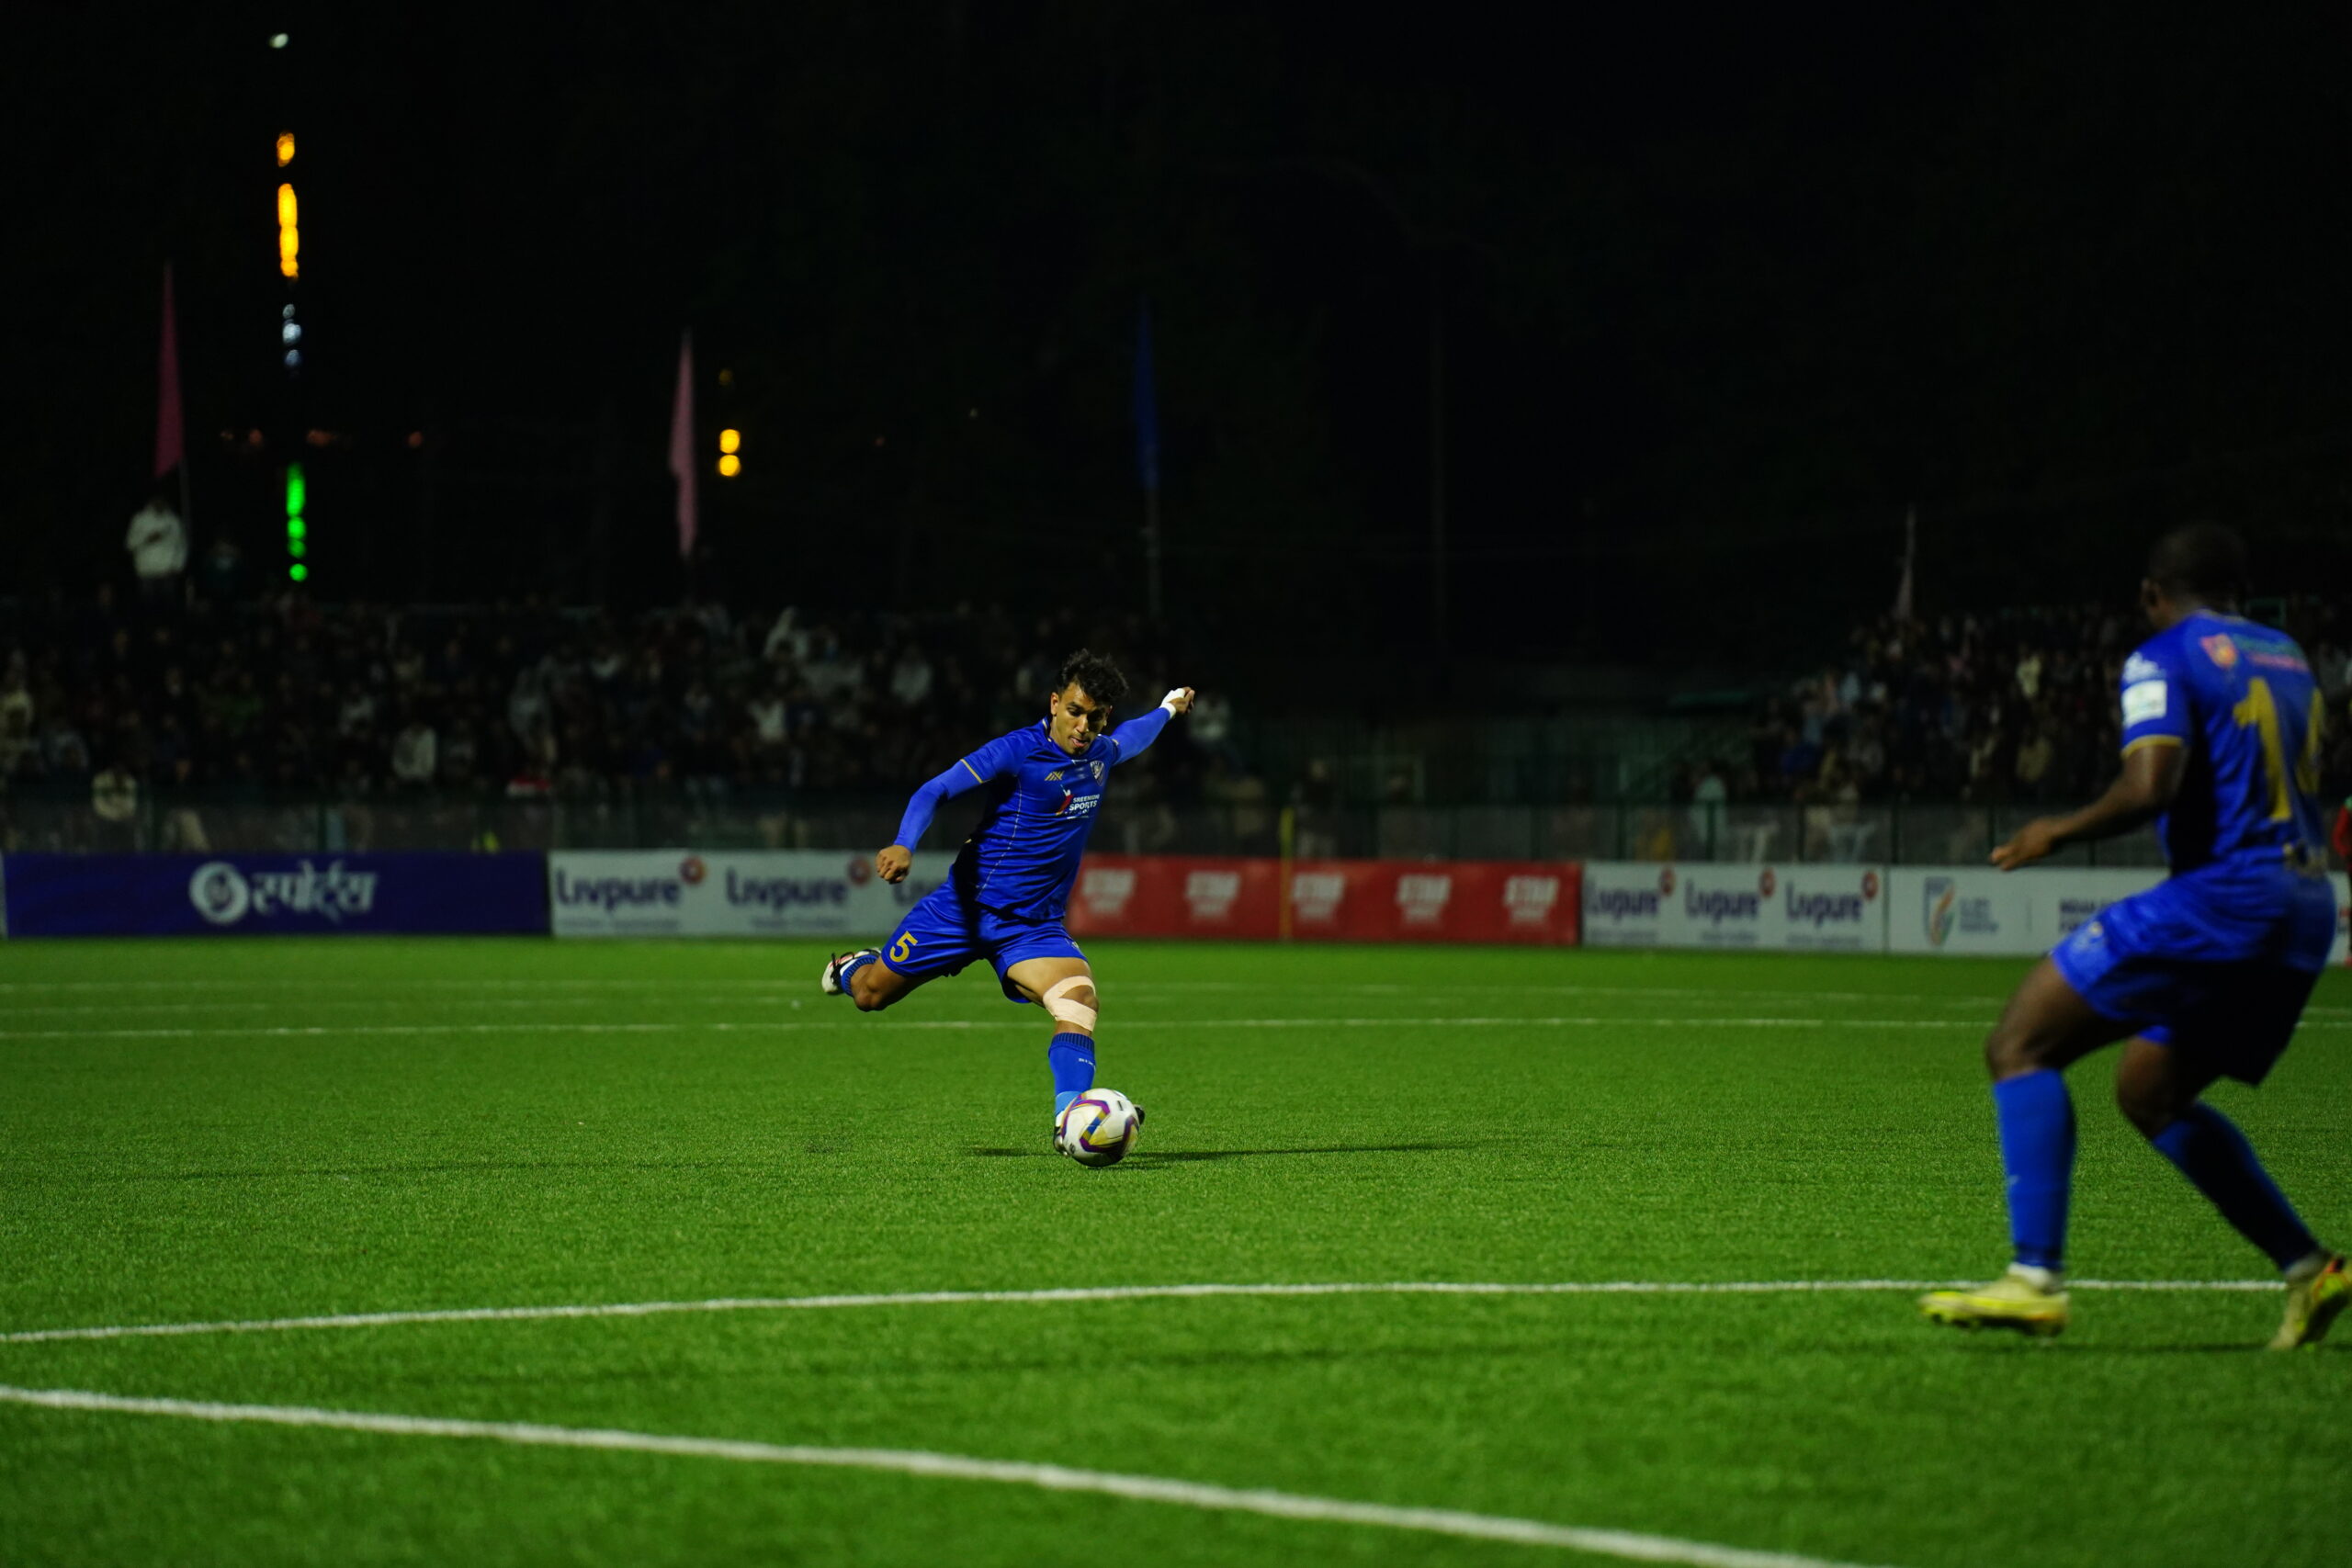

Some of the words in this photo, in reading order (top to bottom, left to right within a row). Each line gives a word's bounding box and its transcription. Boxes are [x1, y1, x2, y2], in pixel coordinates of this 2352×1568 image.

[1069, 800, 1097, 810] SPORTS
[556, 866, 680, 910] Livpure
[726, 866, 848, 909] Livpure
[889, 931, 918, 963] 5
